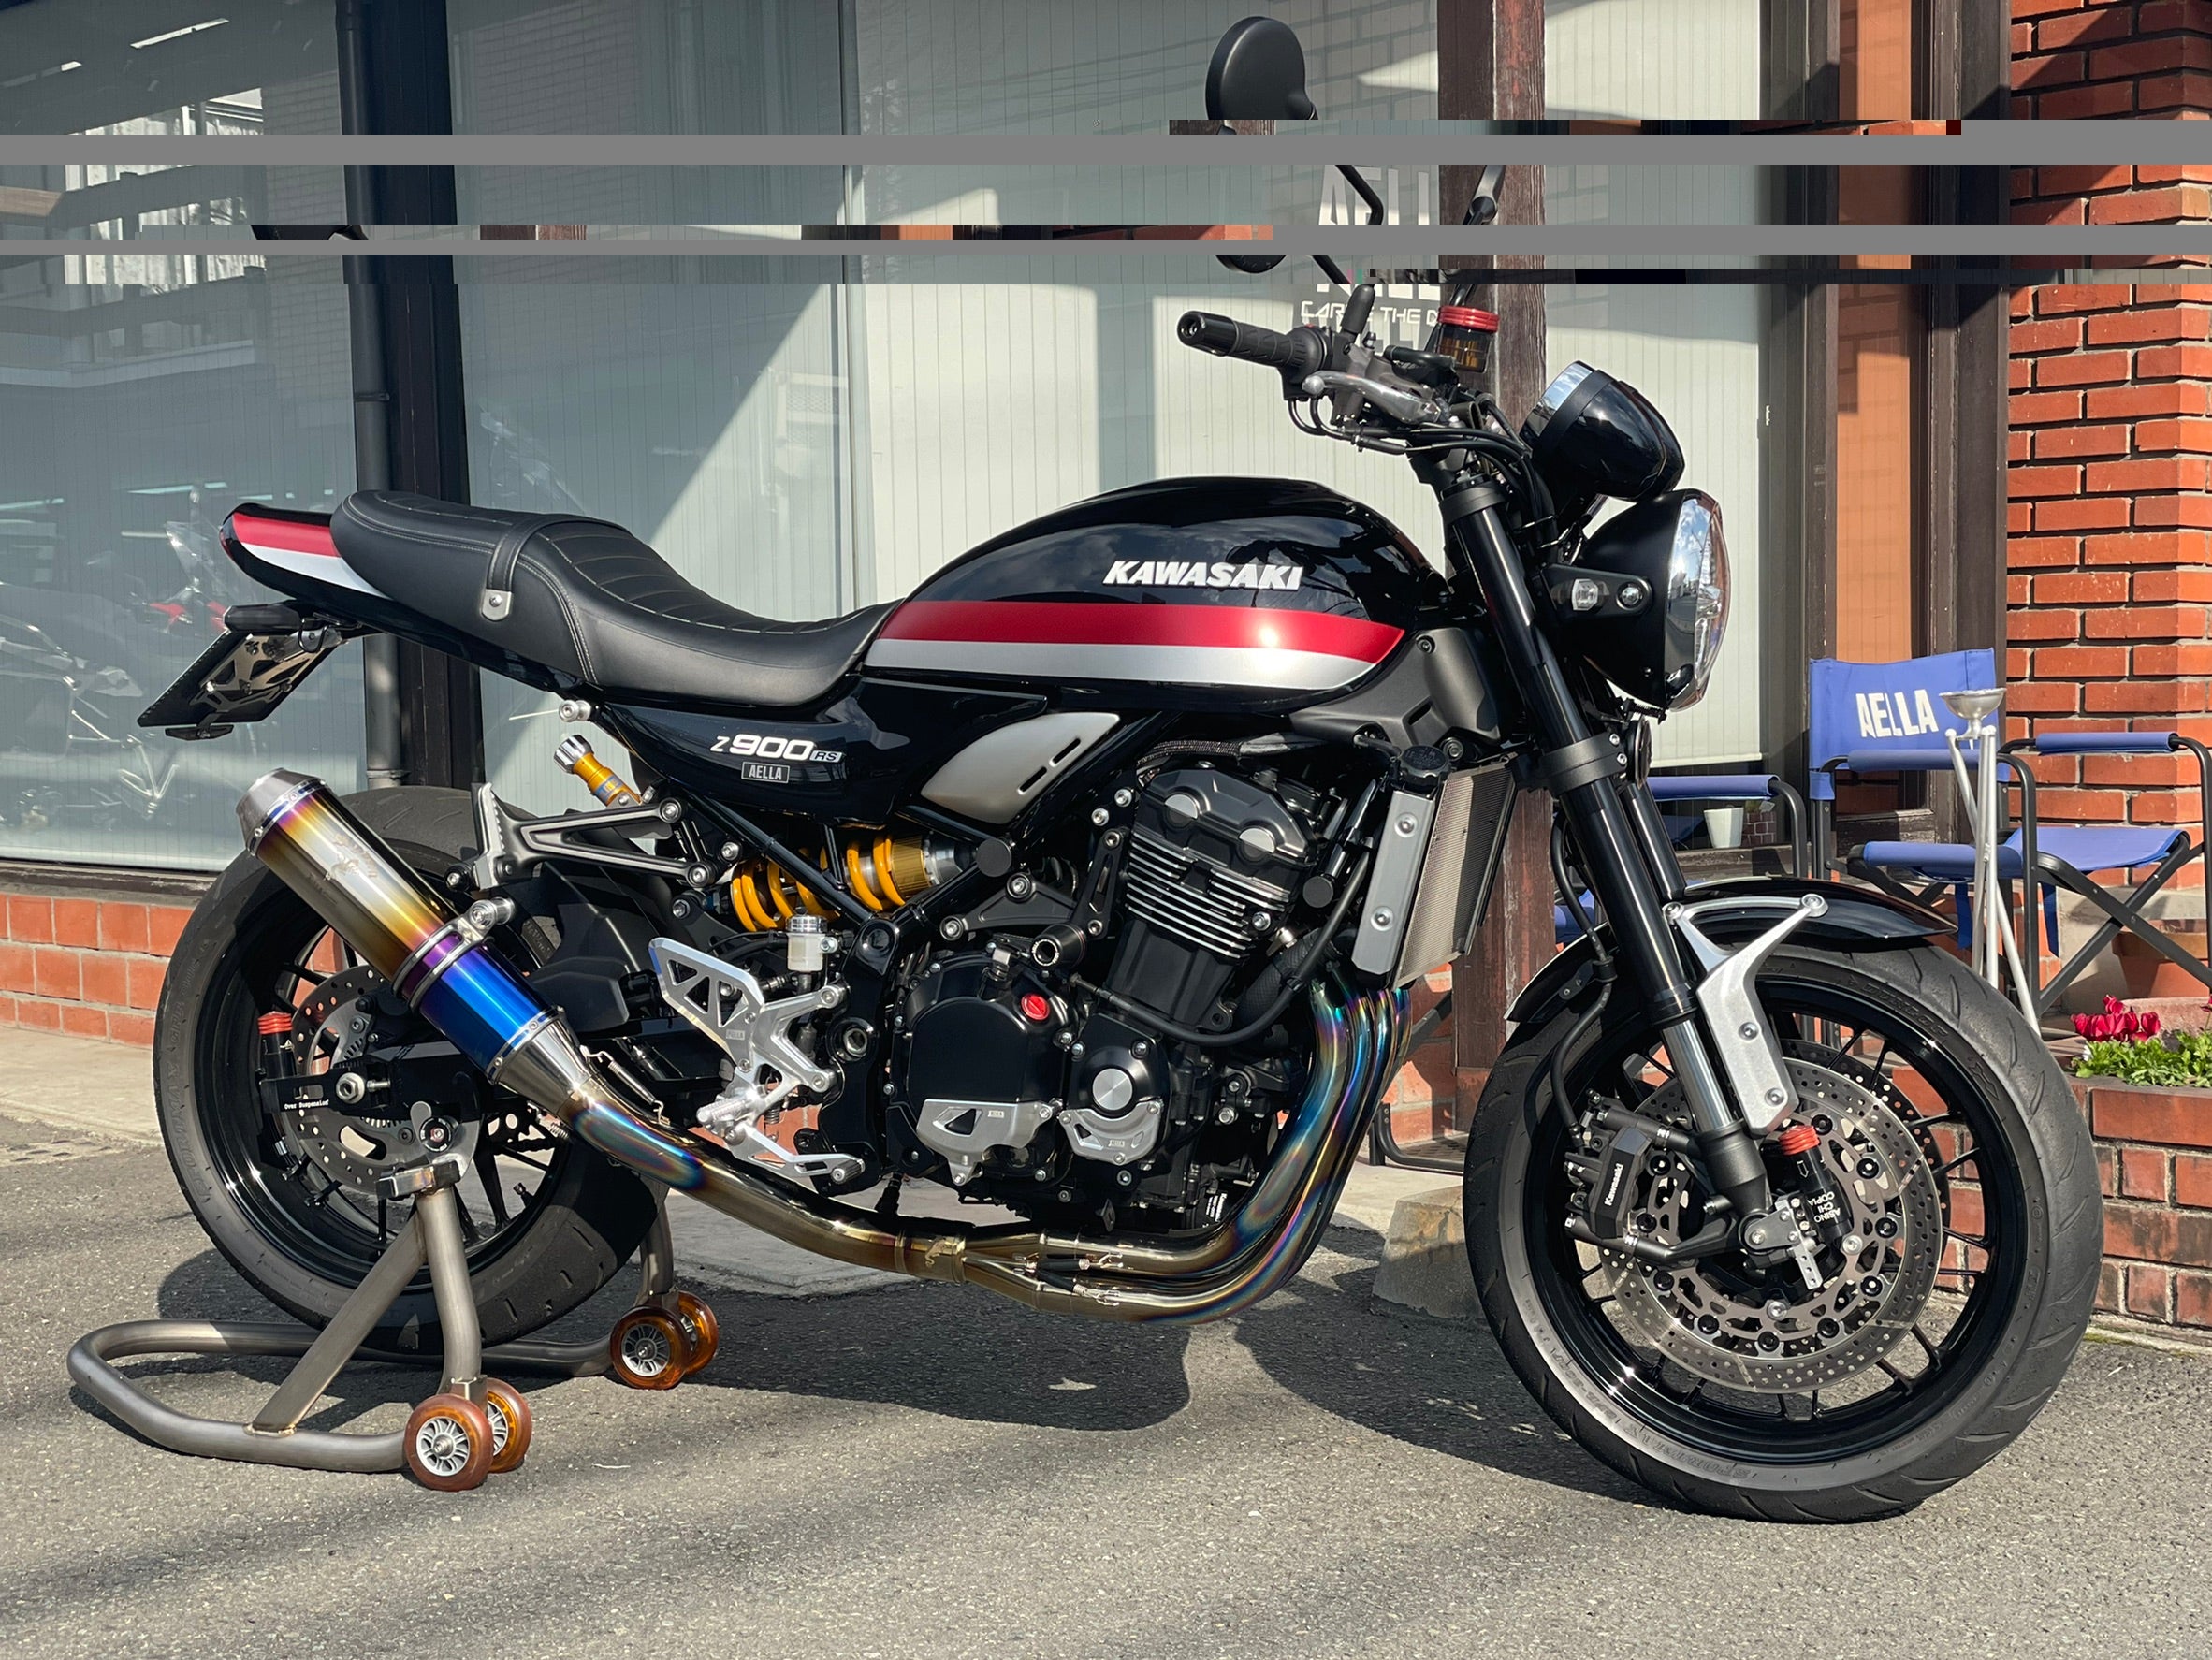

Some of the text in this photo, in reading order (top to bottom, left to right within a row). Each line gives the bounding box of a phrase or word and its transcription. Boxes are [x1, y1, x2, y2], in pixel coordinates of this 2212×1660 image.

[1301, 300, 1375, 323] CAR
[1380, 306, 1421, 324] THE
[1102, 561, 1303, 590] KAWASAKI
[1855, 689, 1939, 738] AELLA
[749, 764, 782, 780] AELLA
[1604, 1162, 1624, 1206] Kawasaki
[1807, 1191, 1835, 1206] COPIA
[1817, 1201, 1834, 1214] CHI
[1813, 1208, 1841, 1223] ASINO
